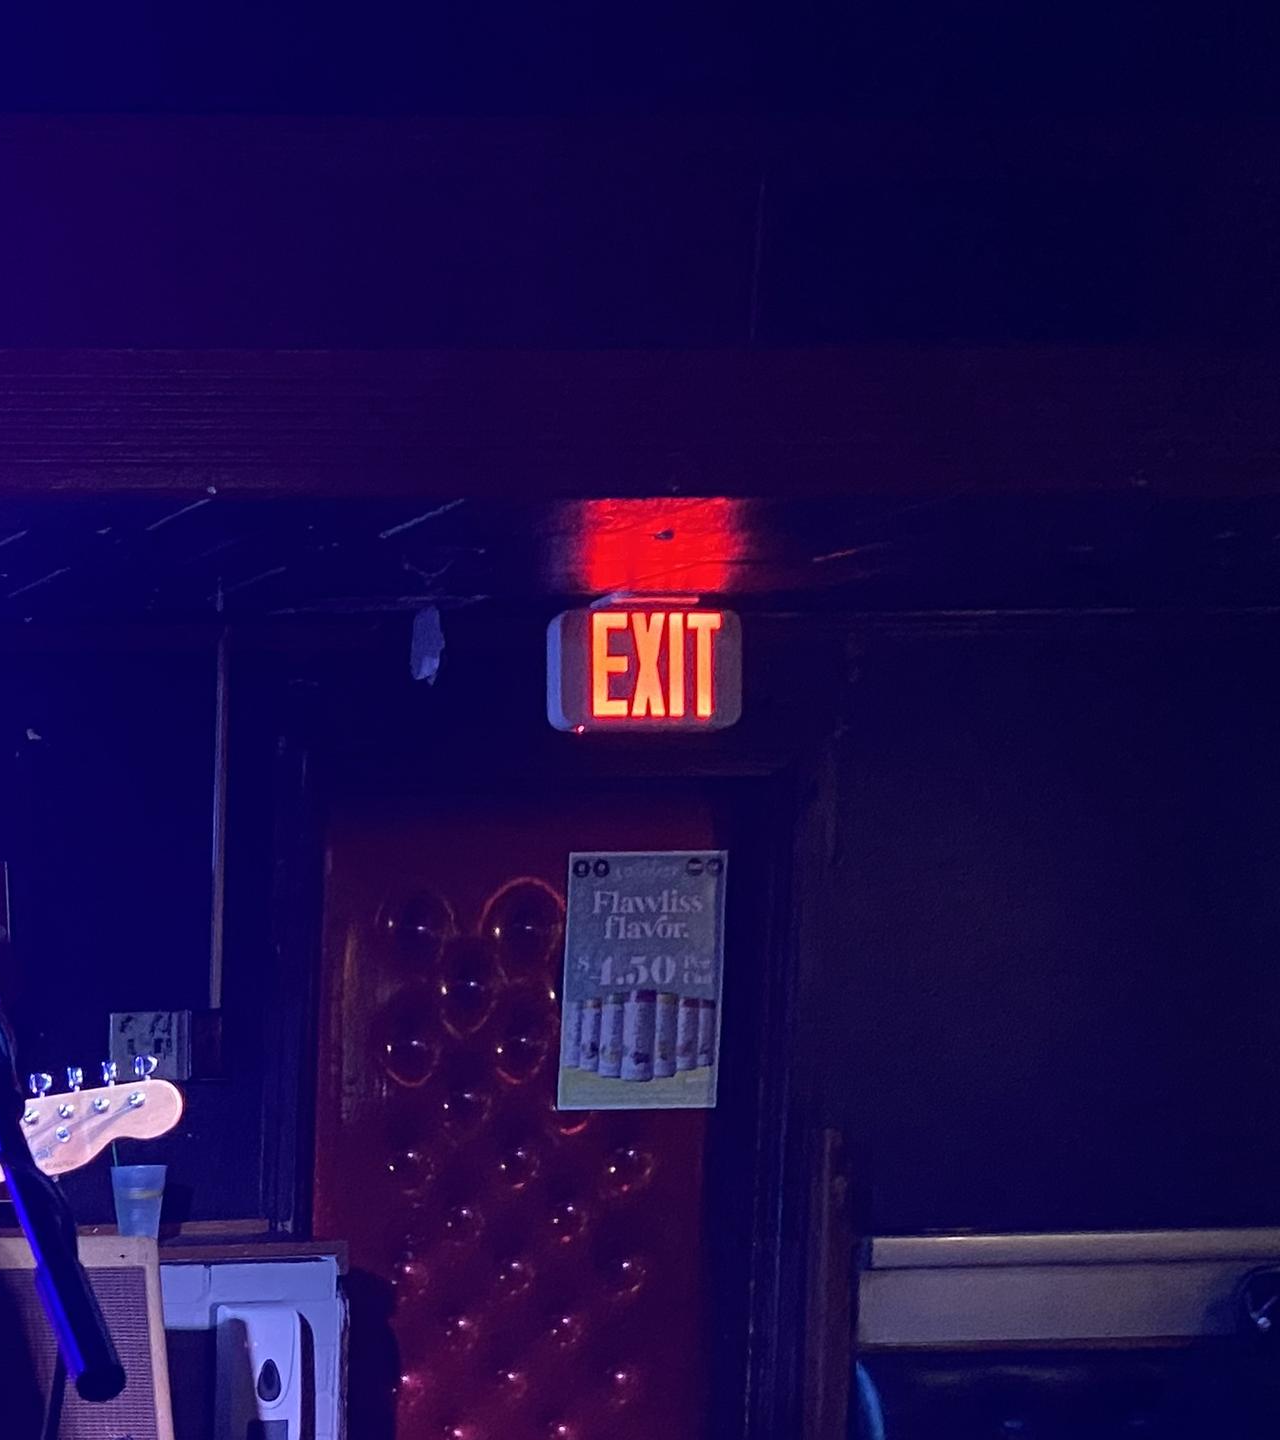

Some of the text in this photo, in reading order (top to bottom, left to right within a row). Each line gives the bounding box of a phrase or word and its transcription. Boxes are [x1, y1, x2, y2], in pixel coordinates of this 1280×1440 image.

[592, 611, 722, 718] EXIT
[592, 889, 704, 914] Flawliss
[603, 914, 690, 940] flavor.
